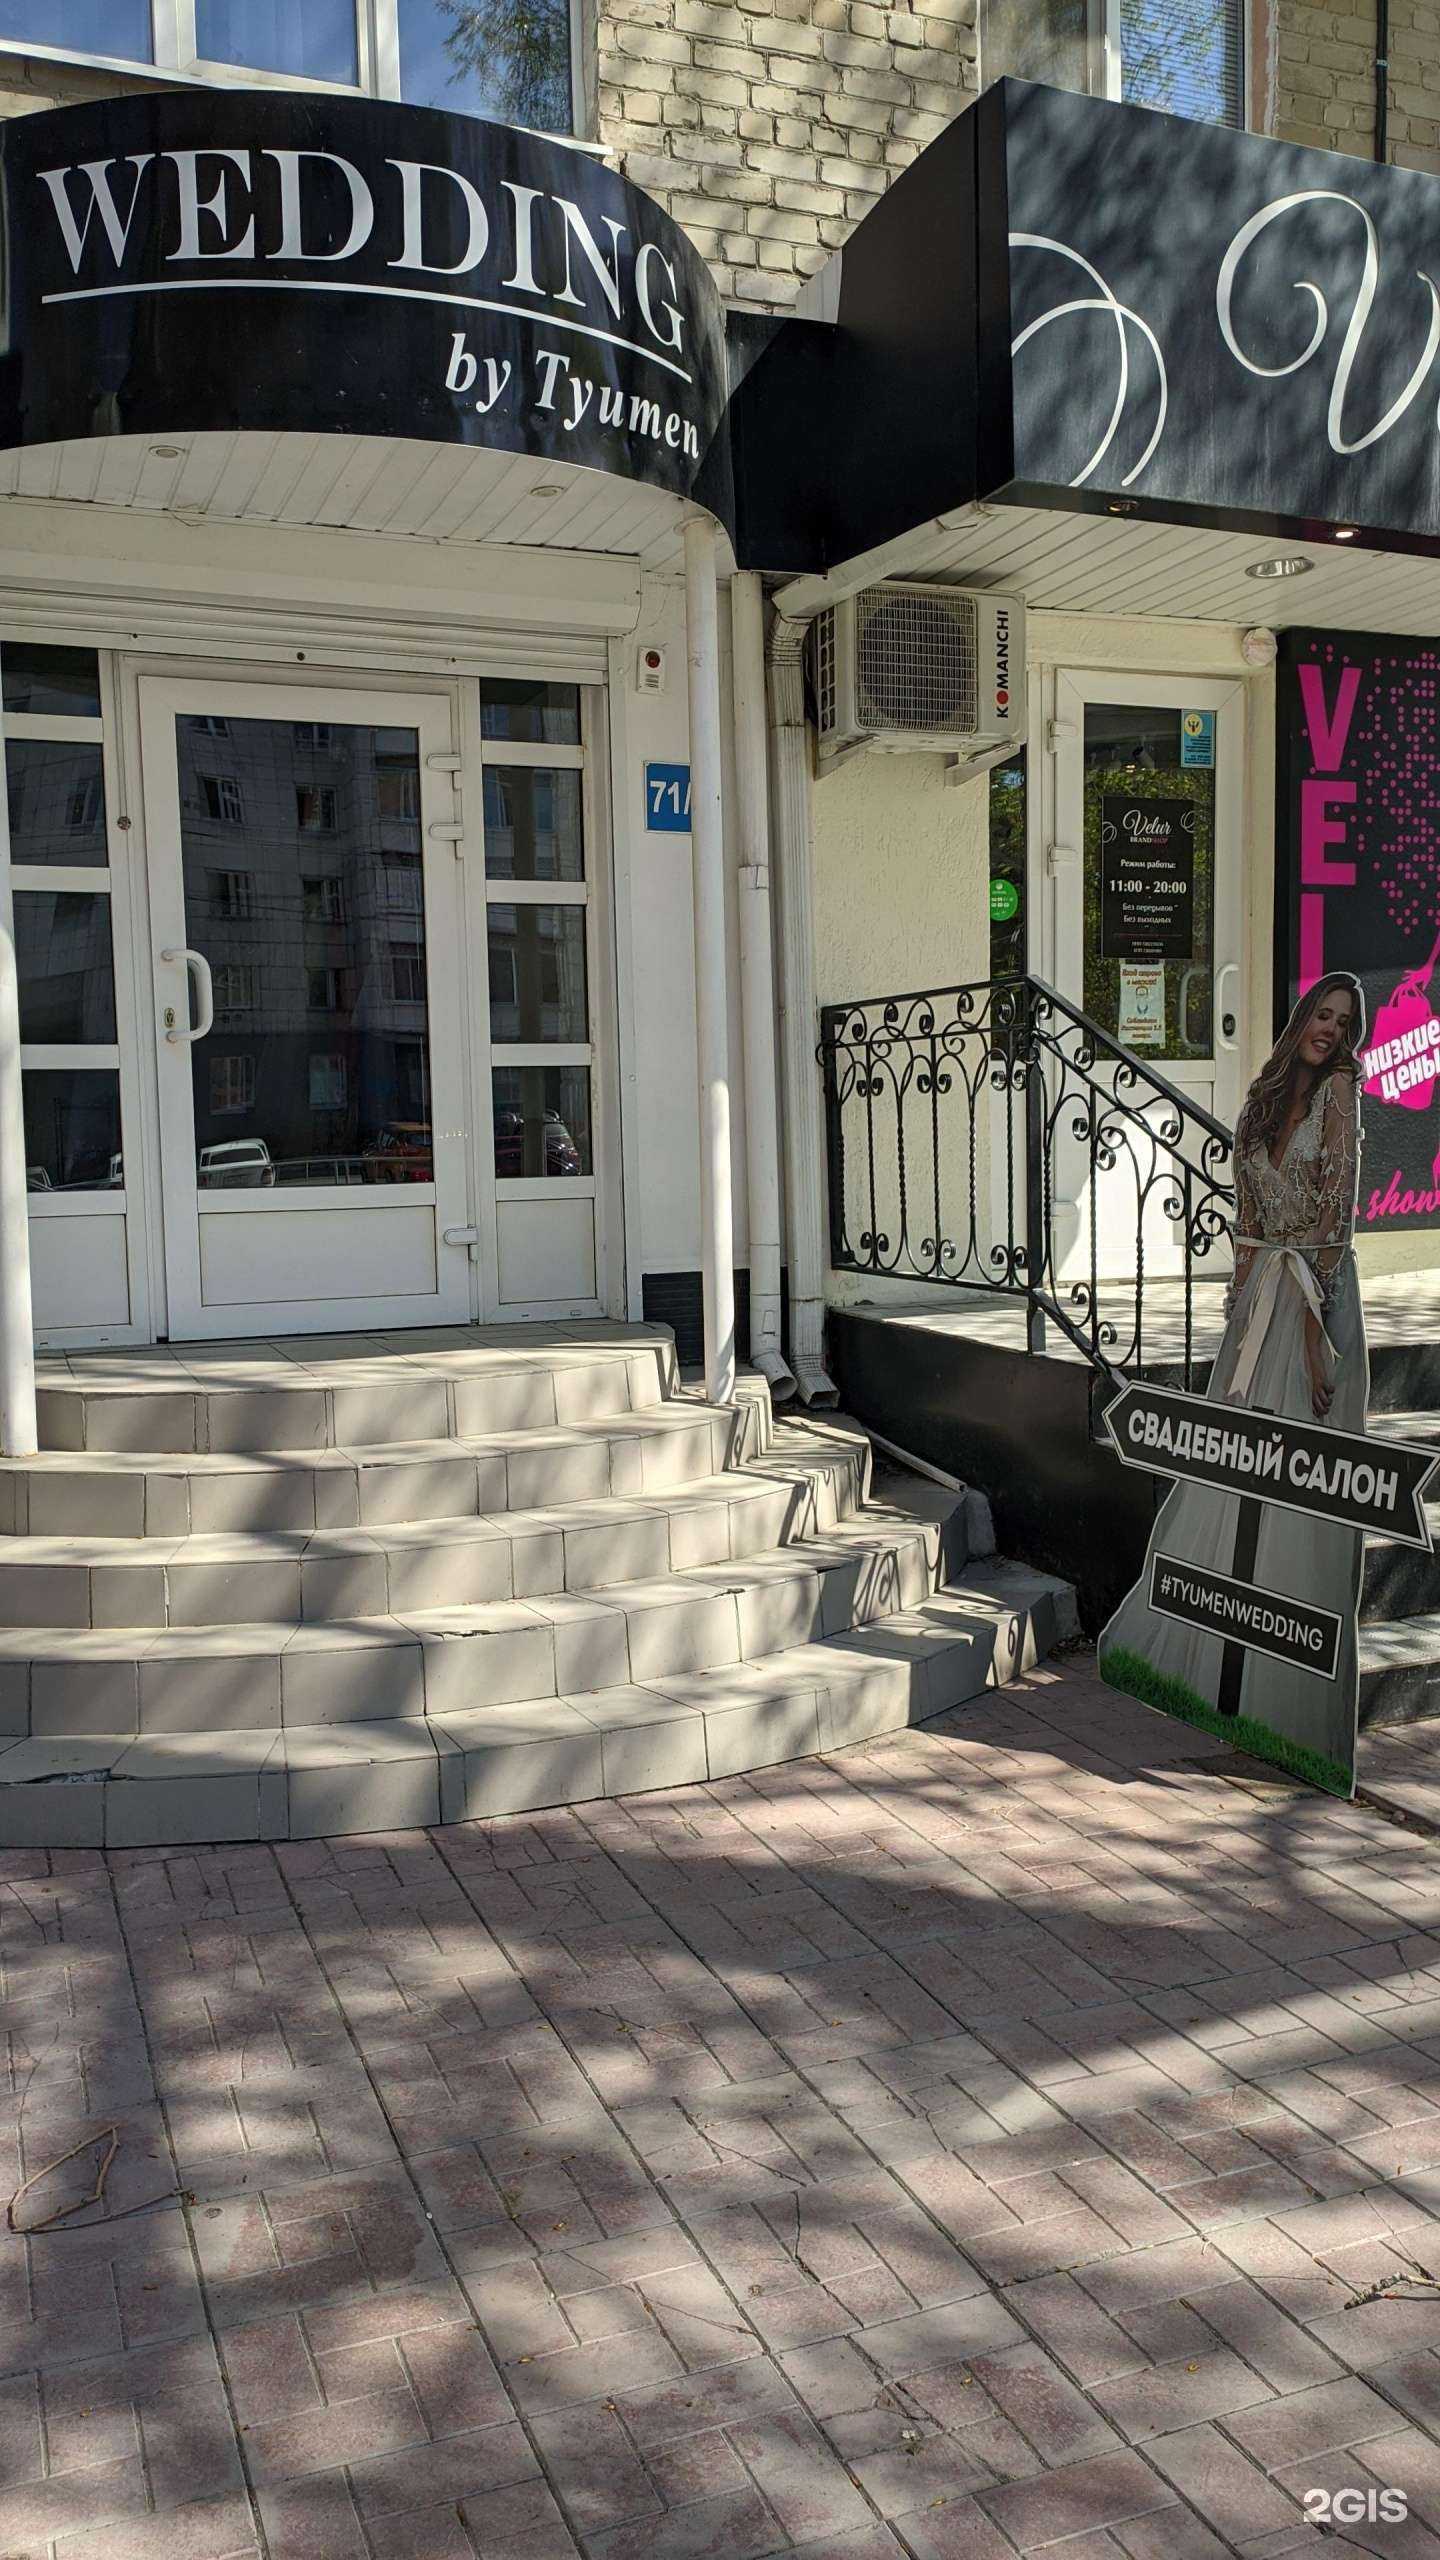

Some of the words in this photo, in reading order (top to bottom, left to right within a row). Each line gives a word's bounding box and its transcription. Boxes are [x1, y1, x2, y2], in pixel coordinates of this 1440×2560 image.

[36, 148, 686, 354] WEDDING
[445, 332, 511, 413] by
[535, 349, 700, 459] Tyumen
[1122, 809, 1173, 836] Velur
[1110, 879, 1143, 893] 11:00
[1153, 880, 1187, 894] 20:00
[1120, 858, 1146, 868] Режим
[1122, 902, 1135, 911] Без
[1128, 1409, 1285, 1481] СВАДЕБНЫЙ
[1288, 1449, 1399, 1511] САЛОН
[1160, 1573, 1324, 1651] #TYUMENWEDDING
